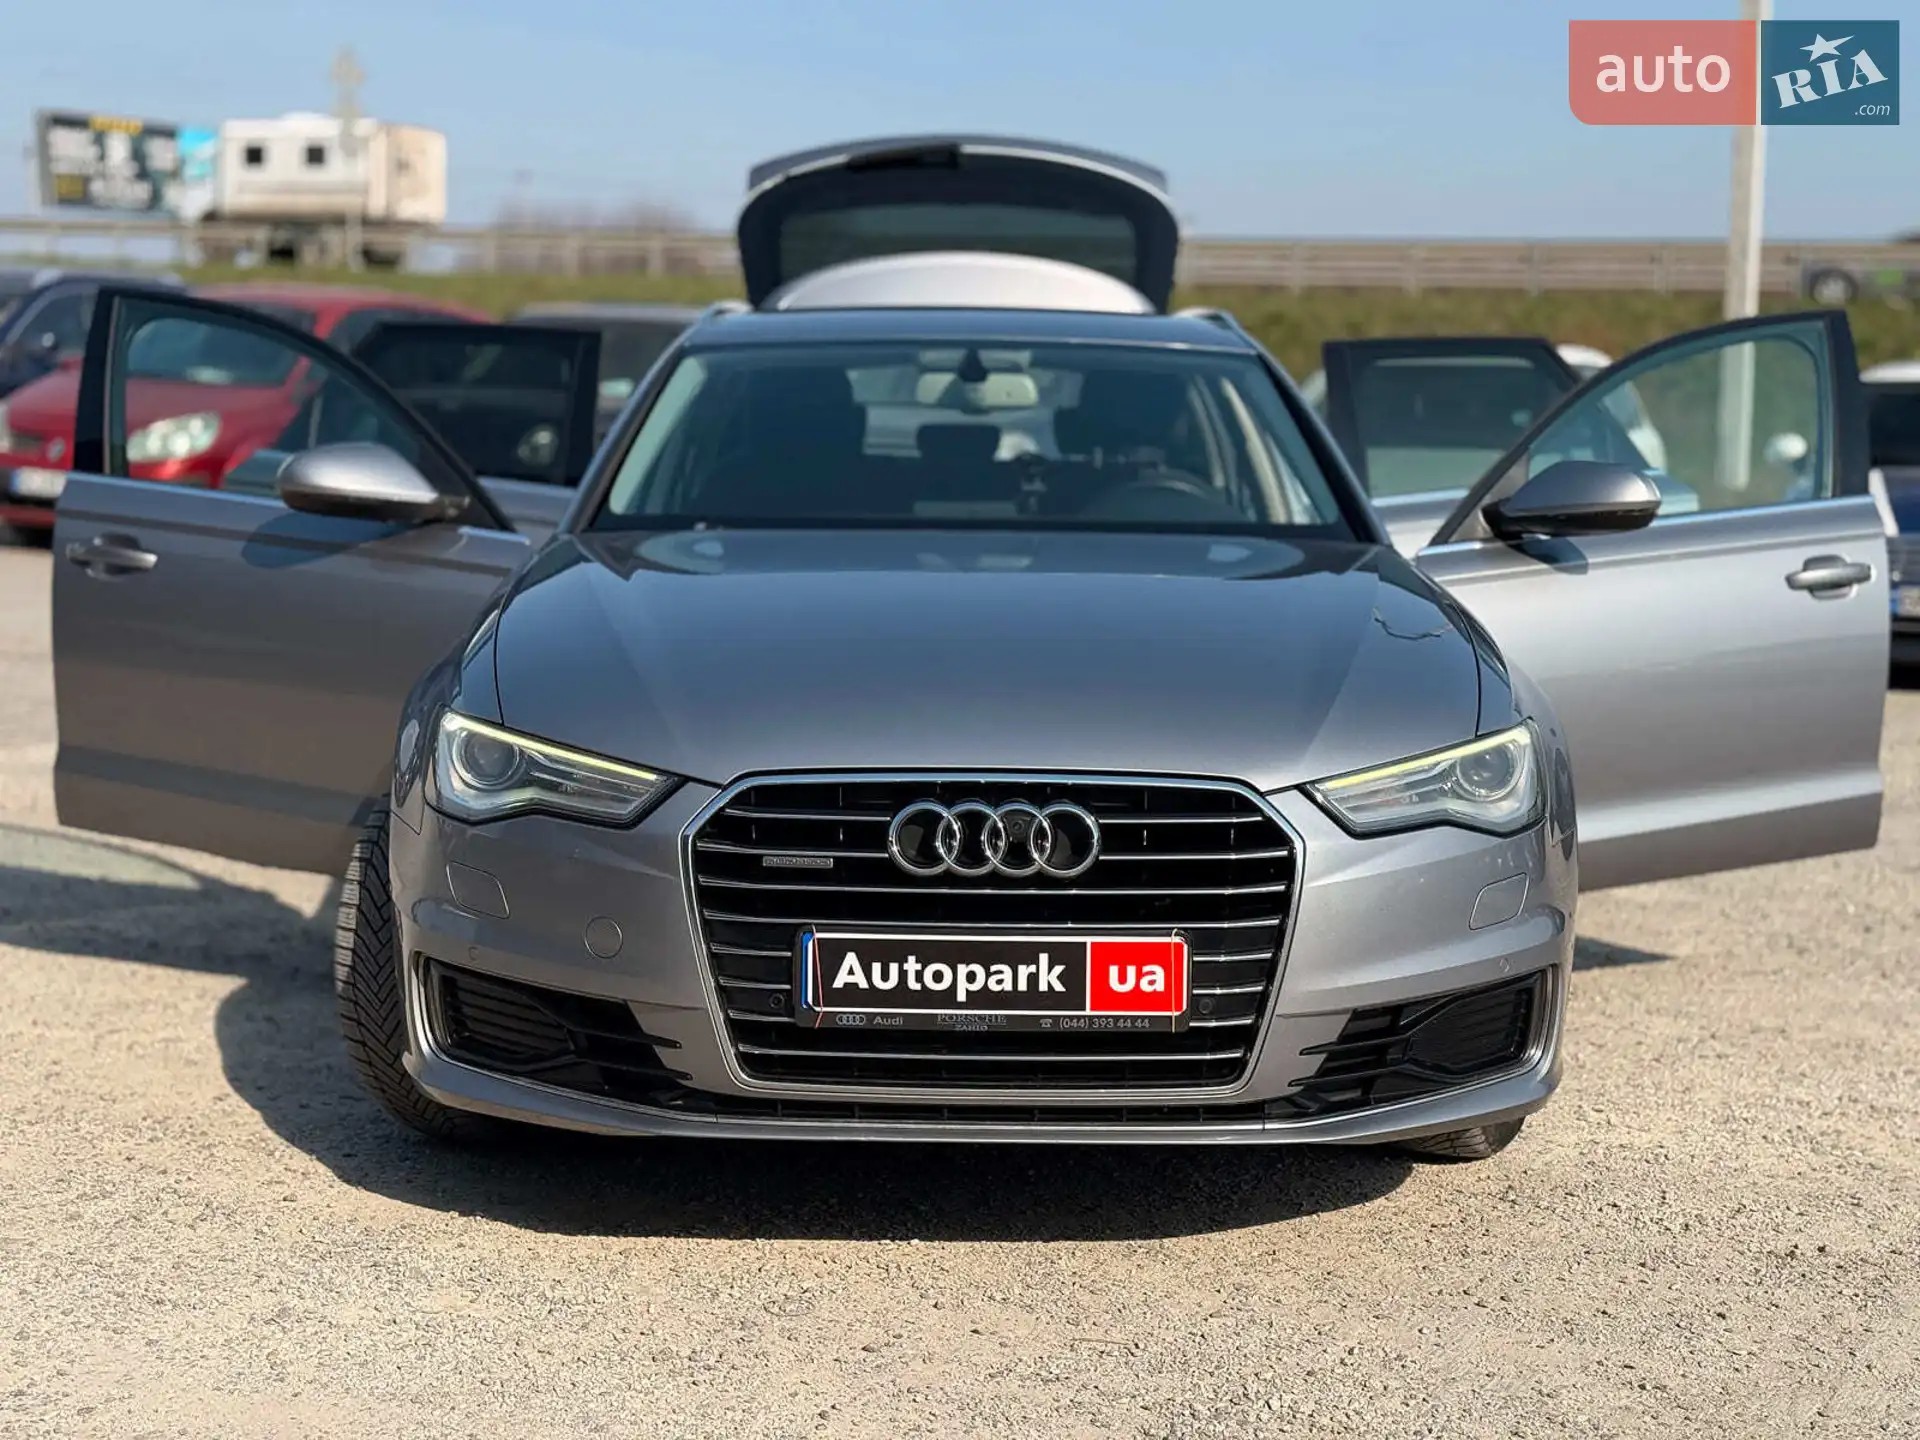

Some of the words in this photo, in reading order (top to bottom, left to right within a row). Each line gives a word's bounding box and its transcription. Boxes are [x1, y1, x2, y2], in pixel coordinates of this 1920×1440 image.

[832, 951, 1066, 1002] Autopark
[1108, 964, 1165, 992] ua
[873, 1015, 903, 1025] Audi
[937, 1014, 1007, 1023] PORSCHE
[1059, 1017, 1089, 1028] (044)
[1092, 1018, 1114, 1028] 393
[1117, 1018, 1131, 1028] 44
[1134, 1018, 1150, 1028] 44
